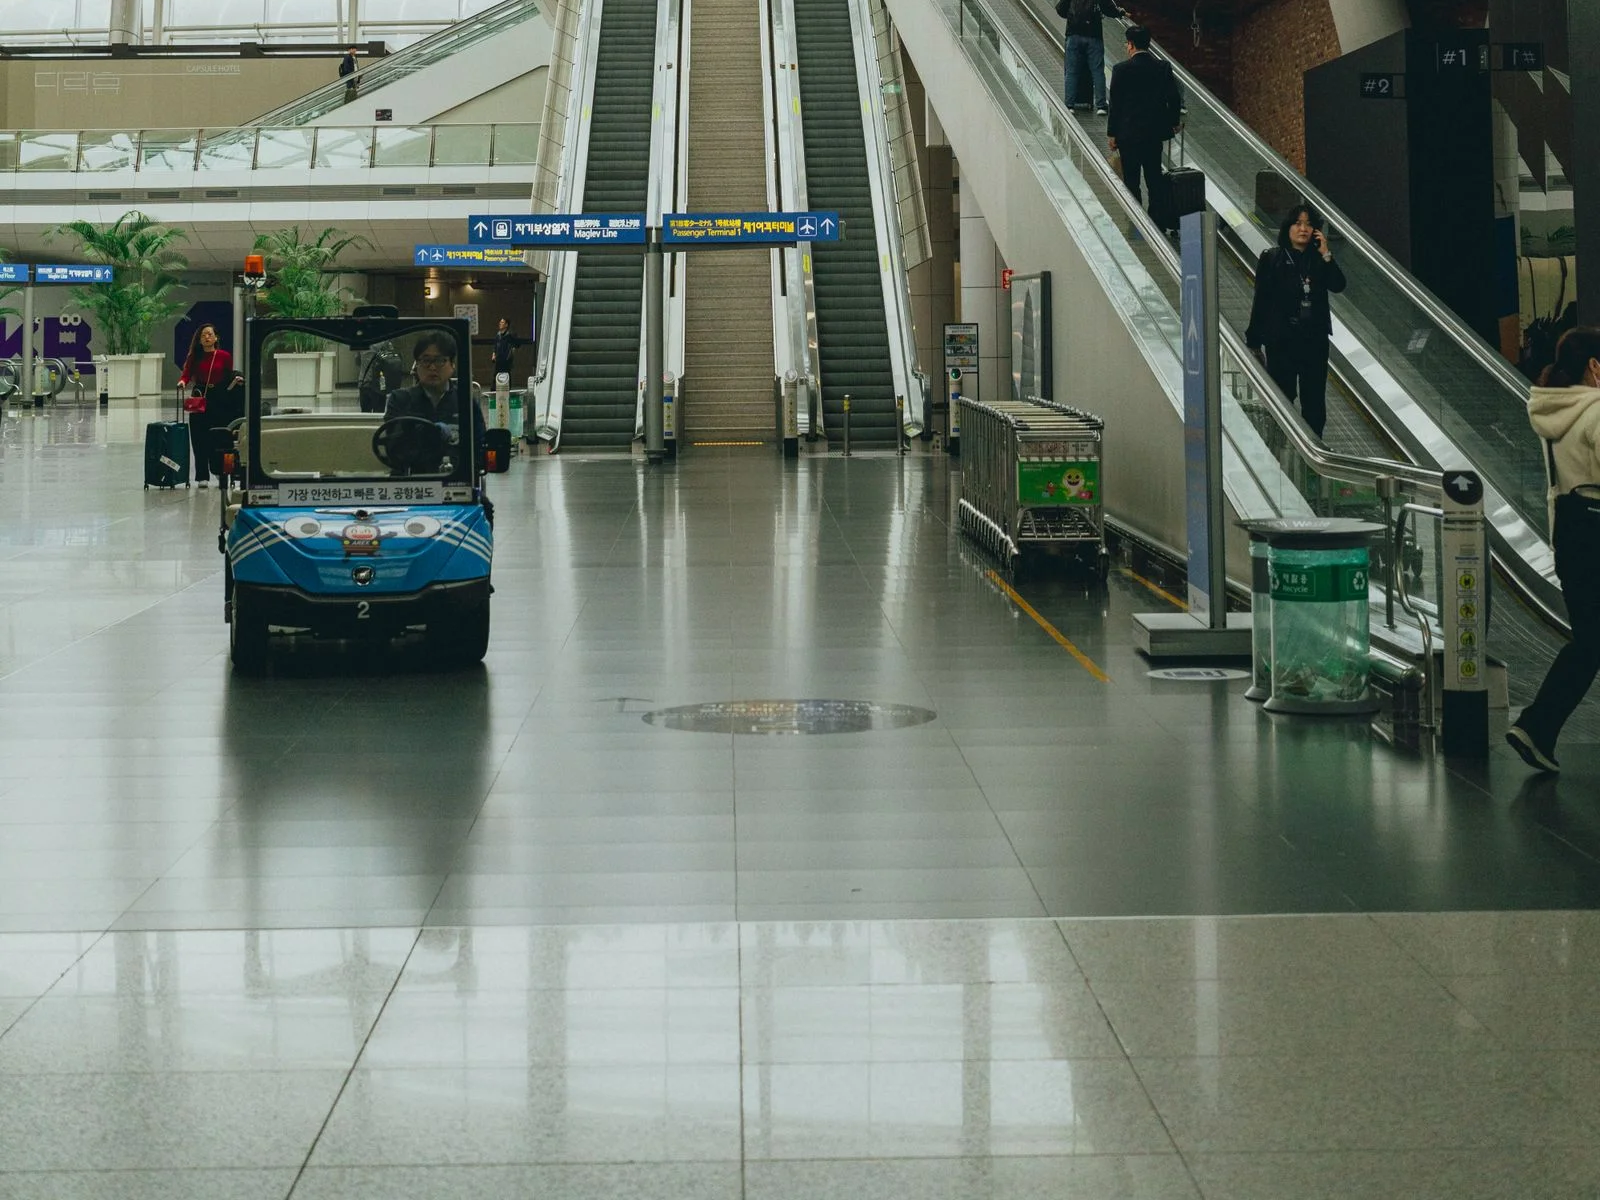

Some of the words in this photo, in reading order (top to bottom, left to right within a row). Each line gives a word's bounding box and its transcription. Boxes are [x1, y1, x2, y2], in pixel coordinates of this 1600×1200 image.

[1442, 49, 1467, 66] #1
[186, 64, 218, 73] CAPSULE
[218, 64, 240, 73] HOTEL
[1363, 78, 1390, 93] #2
[515, 222, 570, 236] 자기부상열차
[673, 228, 706, 239] Passenger
[706, 228, 735, 236] Terminal
[737, 228, 742, 236] 1
[743, 221, 794, 233] 제1여객터미널
[574, 229, 601, 240] Maglev
[602, 229, 618, 238] Line
[288, 488, 308, 502] 가장
[310, 487, 351, 501] 안전하고
[354, 487, 376, 501] 빠른
[378, 487, 391, 501] 길,
[393, 487, 434, 501] 공항철도
[1282, 585, 1309, 594] Recycle
[357, 601, 370, 619] 2
